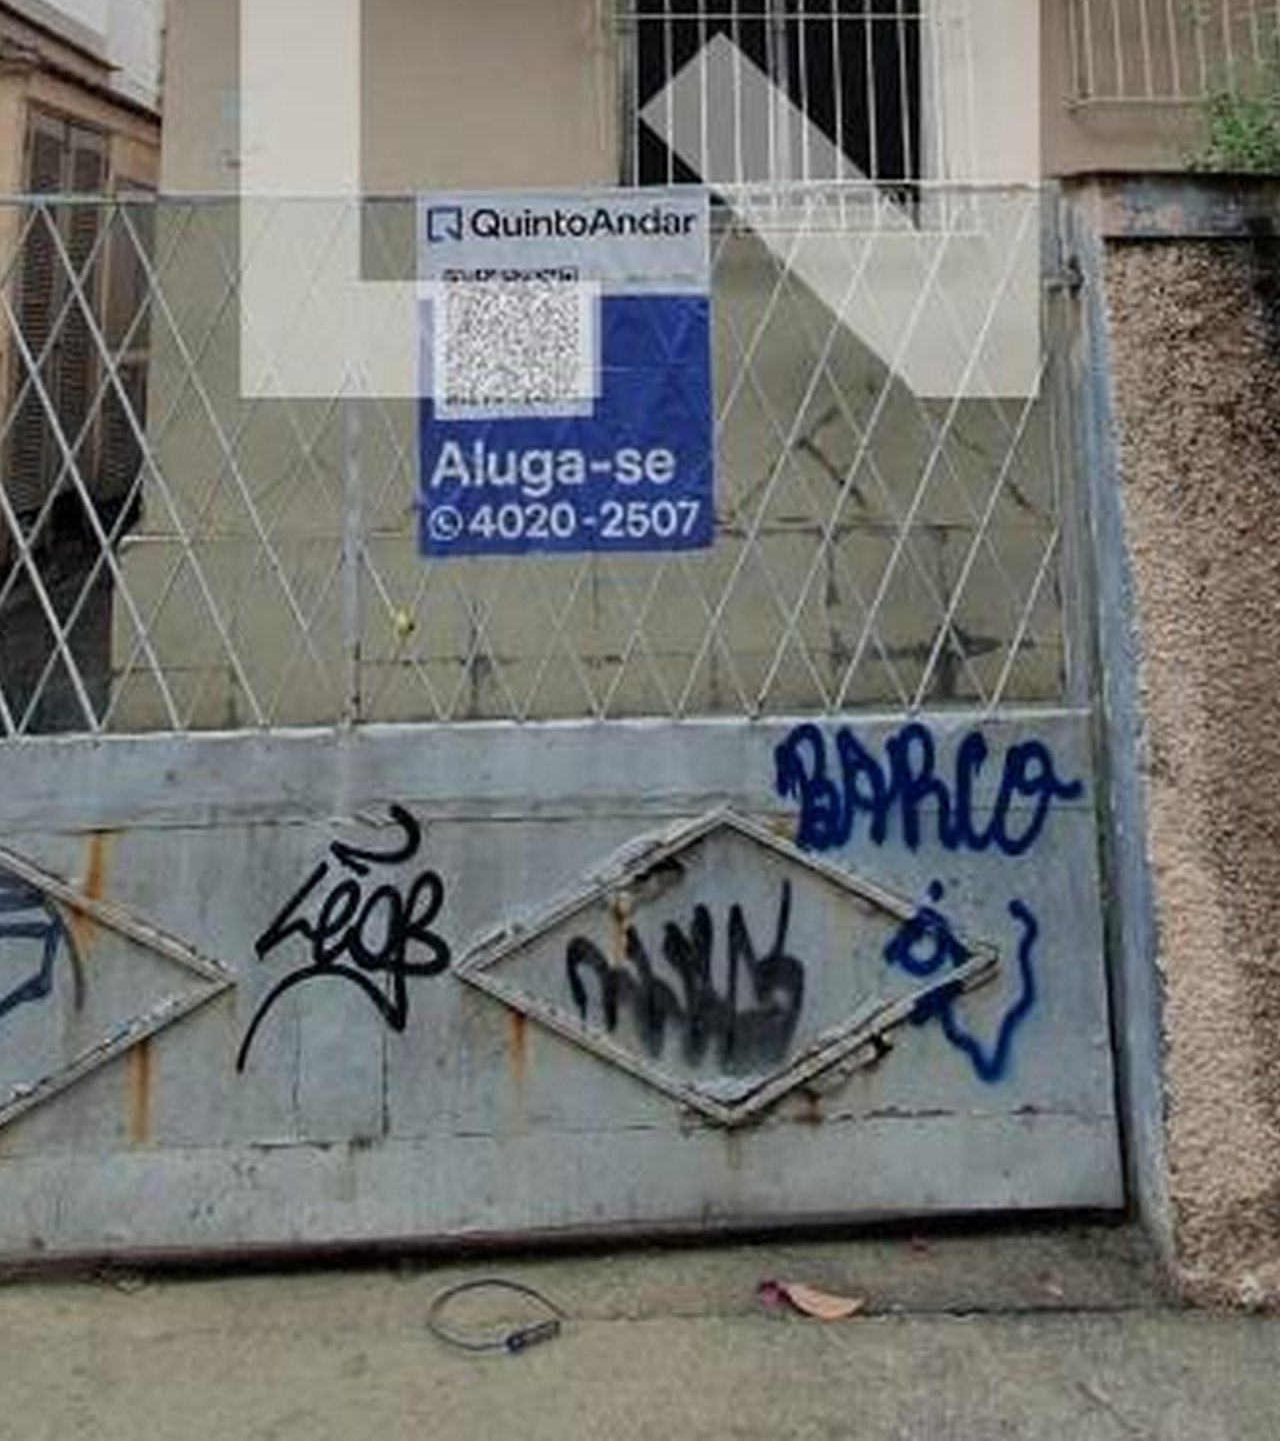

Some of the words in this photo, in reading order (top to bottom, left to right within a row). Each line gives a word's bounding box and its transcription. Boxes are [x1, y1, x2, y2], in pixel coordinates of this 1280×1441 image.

[471, 208, 696, 239] QuintoAndar
[431, 441, 676, 497] Aluga-se
[467, 500, 701, 540] 4020-2507
